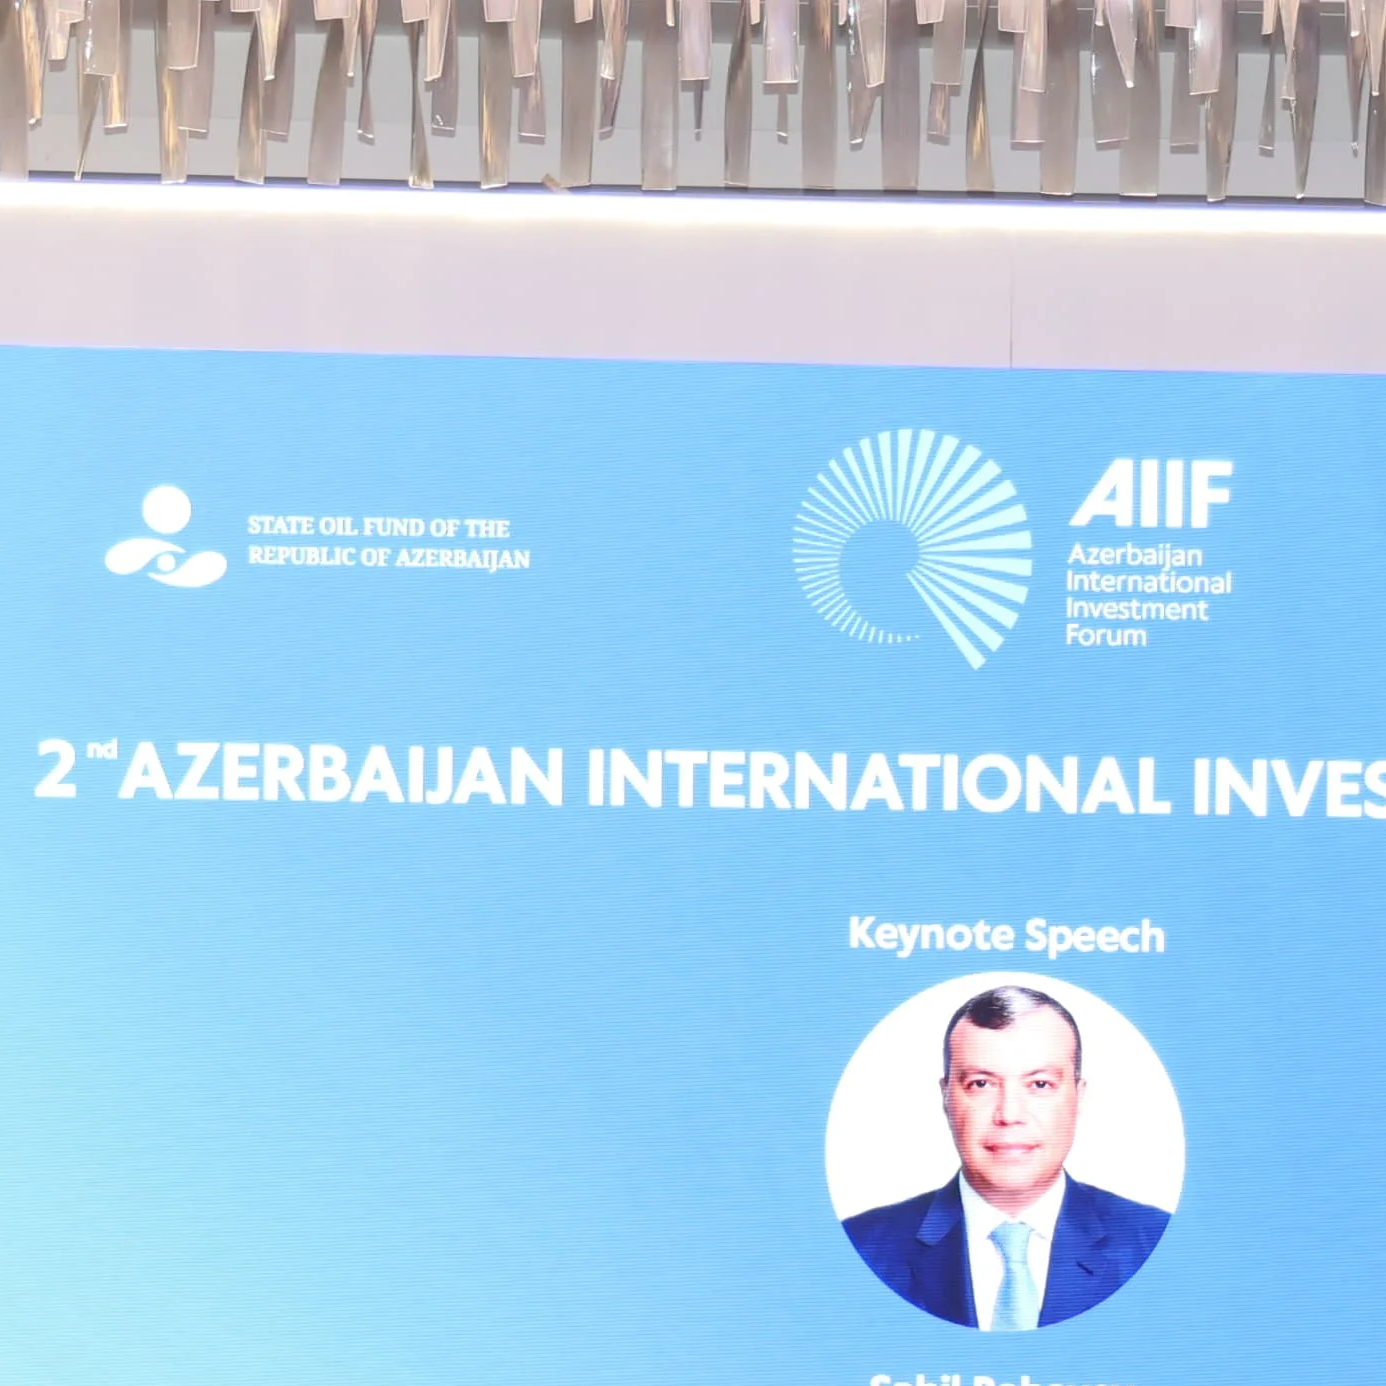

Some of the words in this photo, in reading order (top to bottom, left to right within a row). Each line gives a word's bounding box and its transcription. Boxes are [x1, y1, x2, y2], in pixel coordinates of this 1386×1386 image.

[1069, 458, 1234, 529] AIIF
[248, 515, 315, 536] STATE
[319, 516, 360, 537] OIL
[363, 517, 425, 538] FUND
[429, 518, 461, 538] OF
[464, 519, 511, 539] THE
[248, 546, 356, 567] REPUBLIC
[360, 548, 391, 568] OF
[395, 548, 531, 573] AZERBAIJAN
[1067, 543, 1204, 570] Azerbaijan
[1066, 569, 1233, 595] International
[1066, 597, 1210, 622] Investment
[1066, 623, 1148, 648] Forum
[116, 741, 564, 806] AZERBAIJAN
[588, 748, 1173, 815] INTERNATIONAL
[849, 916, 1015, 959] Keynote
[1025, 917, 1165, 960] Speech
